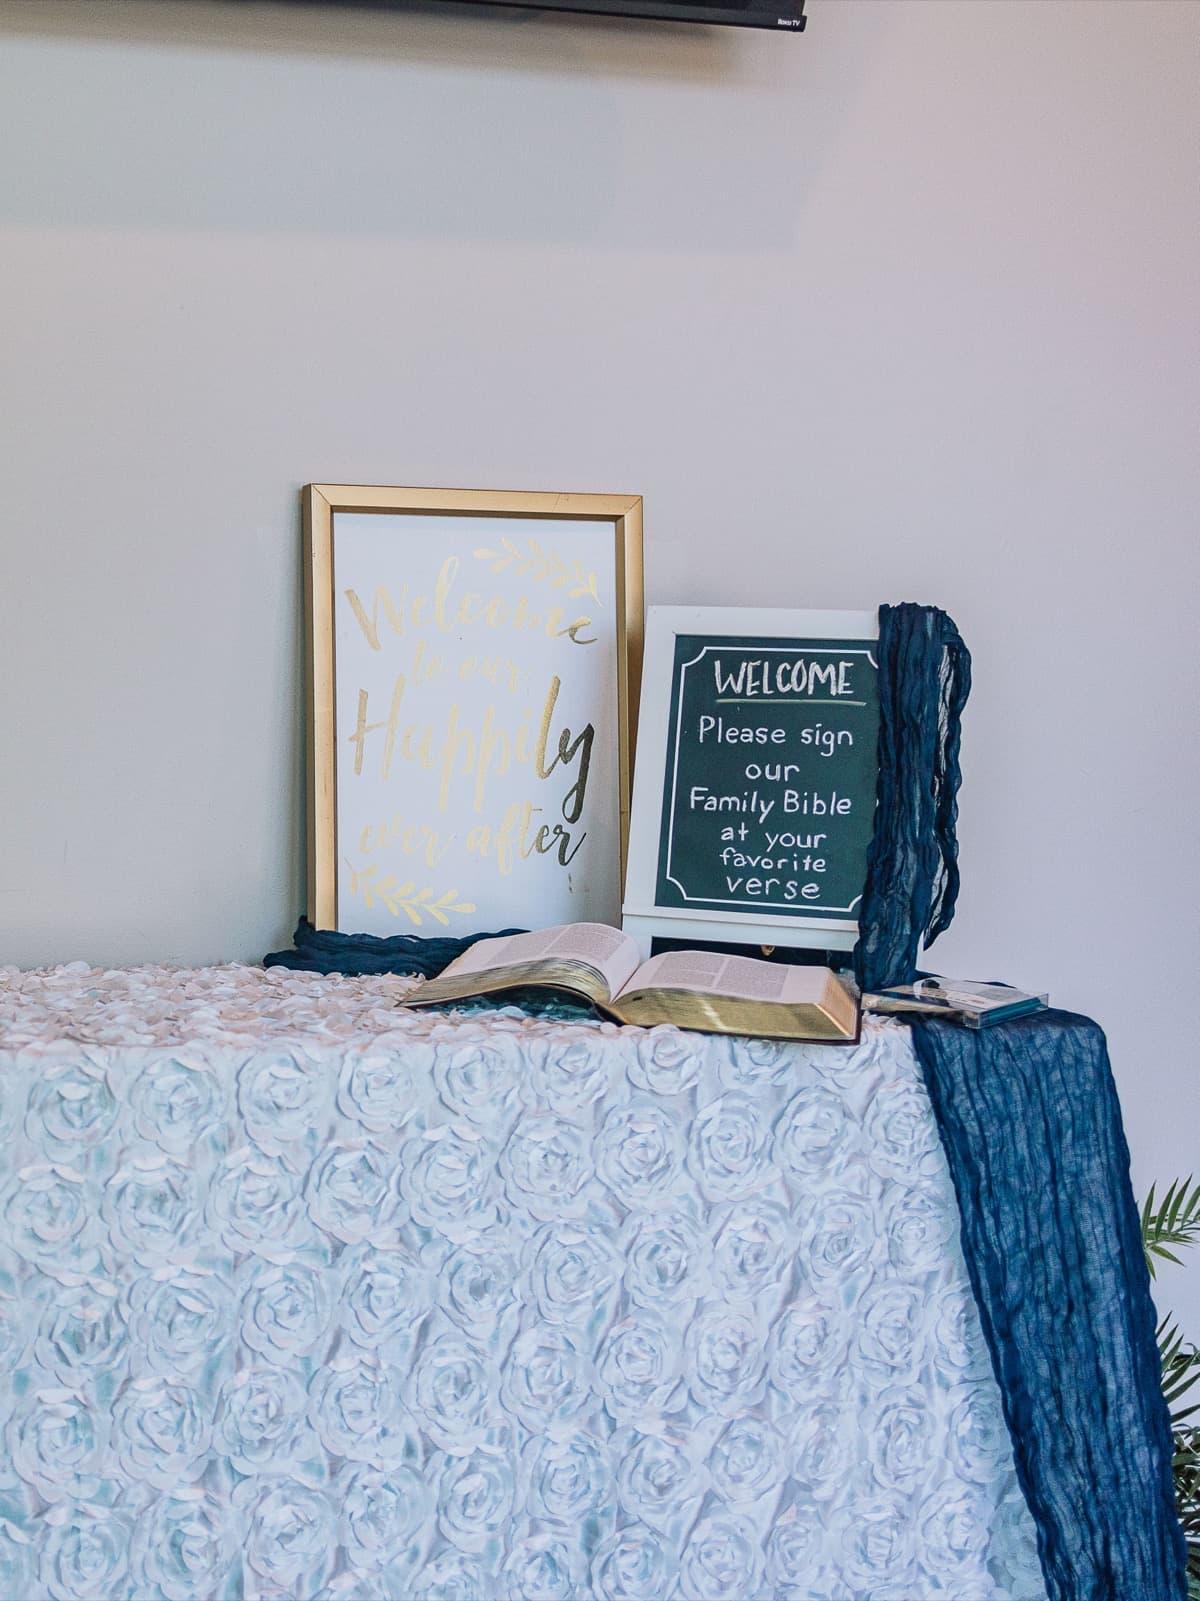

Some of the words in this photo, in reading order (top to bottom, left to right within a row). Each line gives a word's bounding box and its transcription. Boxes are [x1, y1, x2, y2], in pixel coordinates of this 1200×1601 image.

[344, 556, 598, 651] Welcome
[458, 654, 527, 694] our
[713, 659, 855, 697] WELCOME
[348, 675, 596, 824] Happily
[698, 715, 787, 745] Please
[800, 723, 854, 757] sign
[744, 763, 801, 782] our
[689, 786, 775, 824] Family
[783, 789, 852, 816] Bible
[359, 811, 456, 869] ever
[466, 799, 587, 878] after
[720, 822, 749, 842] at
[764, 832, 828, 853] your
[718, 846, 827, 873] favorite
[726, 876, 821, 901] verse
